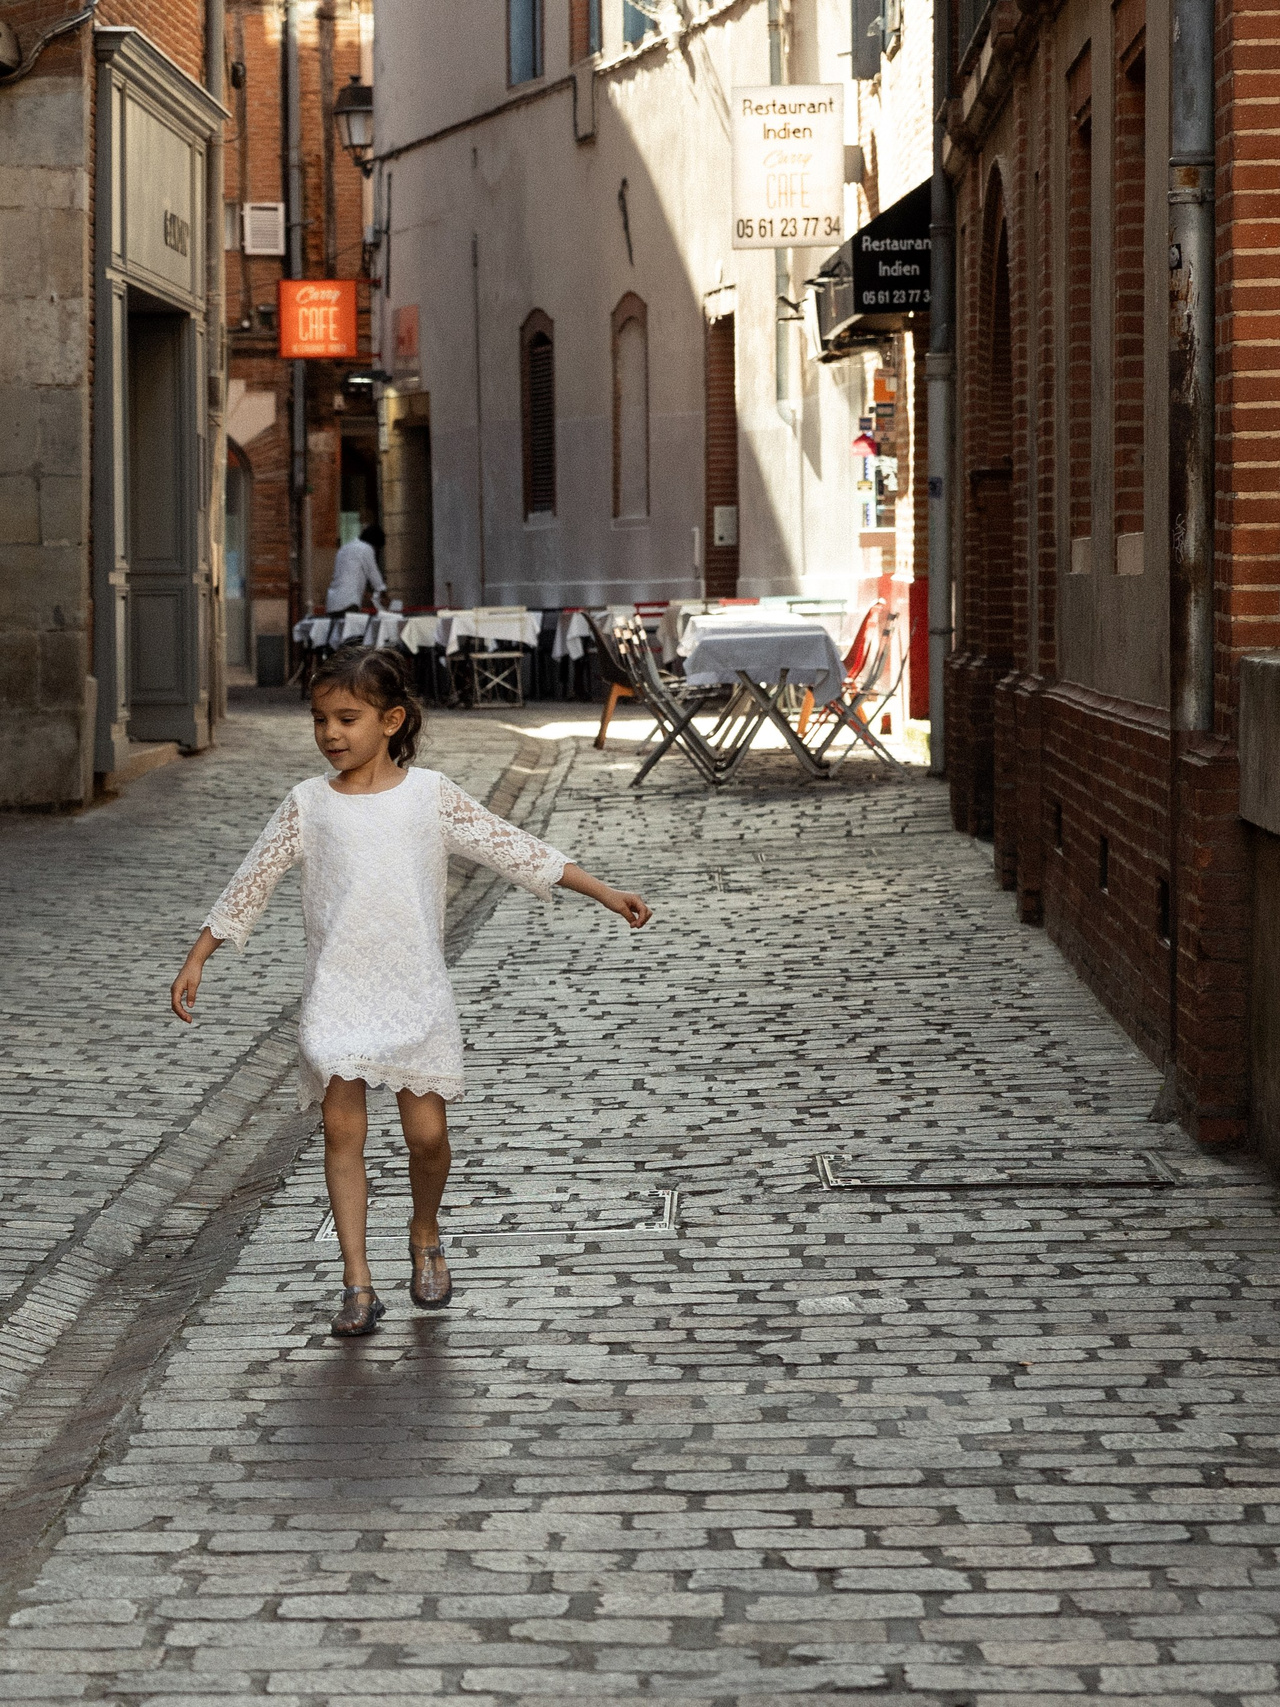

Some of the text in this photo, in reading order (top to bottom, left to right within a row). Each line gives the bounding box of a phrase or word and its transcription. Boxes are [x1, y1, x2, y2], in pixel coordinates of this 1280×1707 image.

[742, 98, 835, 116] Restaurant
[763, 122, 813, 139] Indien
[766, 172, 811, 209] CAFE
[736, 216, 841, 238] 05 61 23 77 34
[862, 235, 932, 252] Restauran
[878, 260, 920, 277] Indien
[862, 288, 931, 305] 05 61 23 77 3
[298, 307, 339, 341] CAFE
